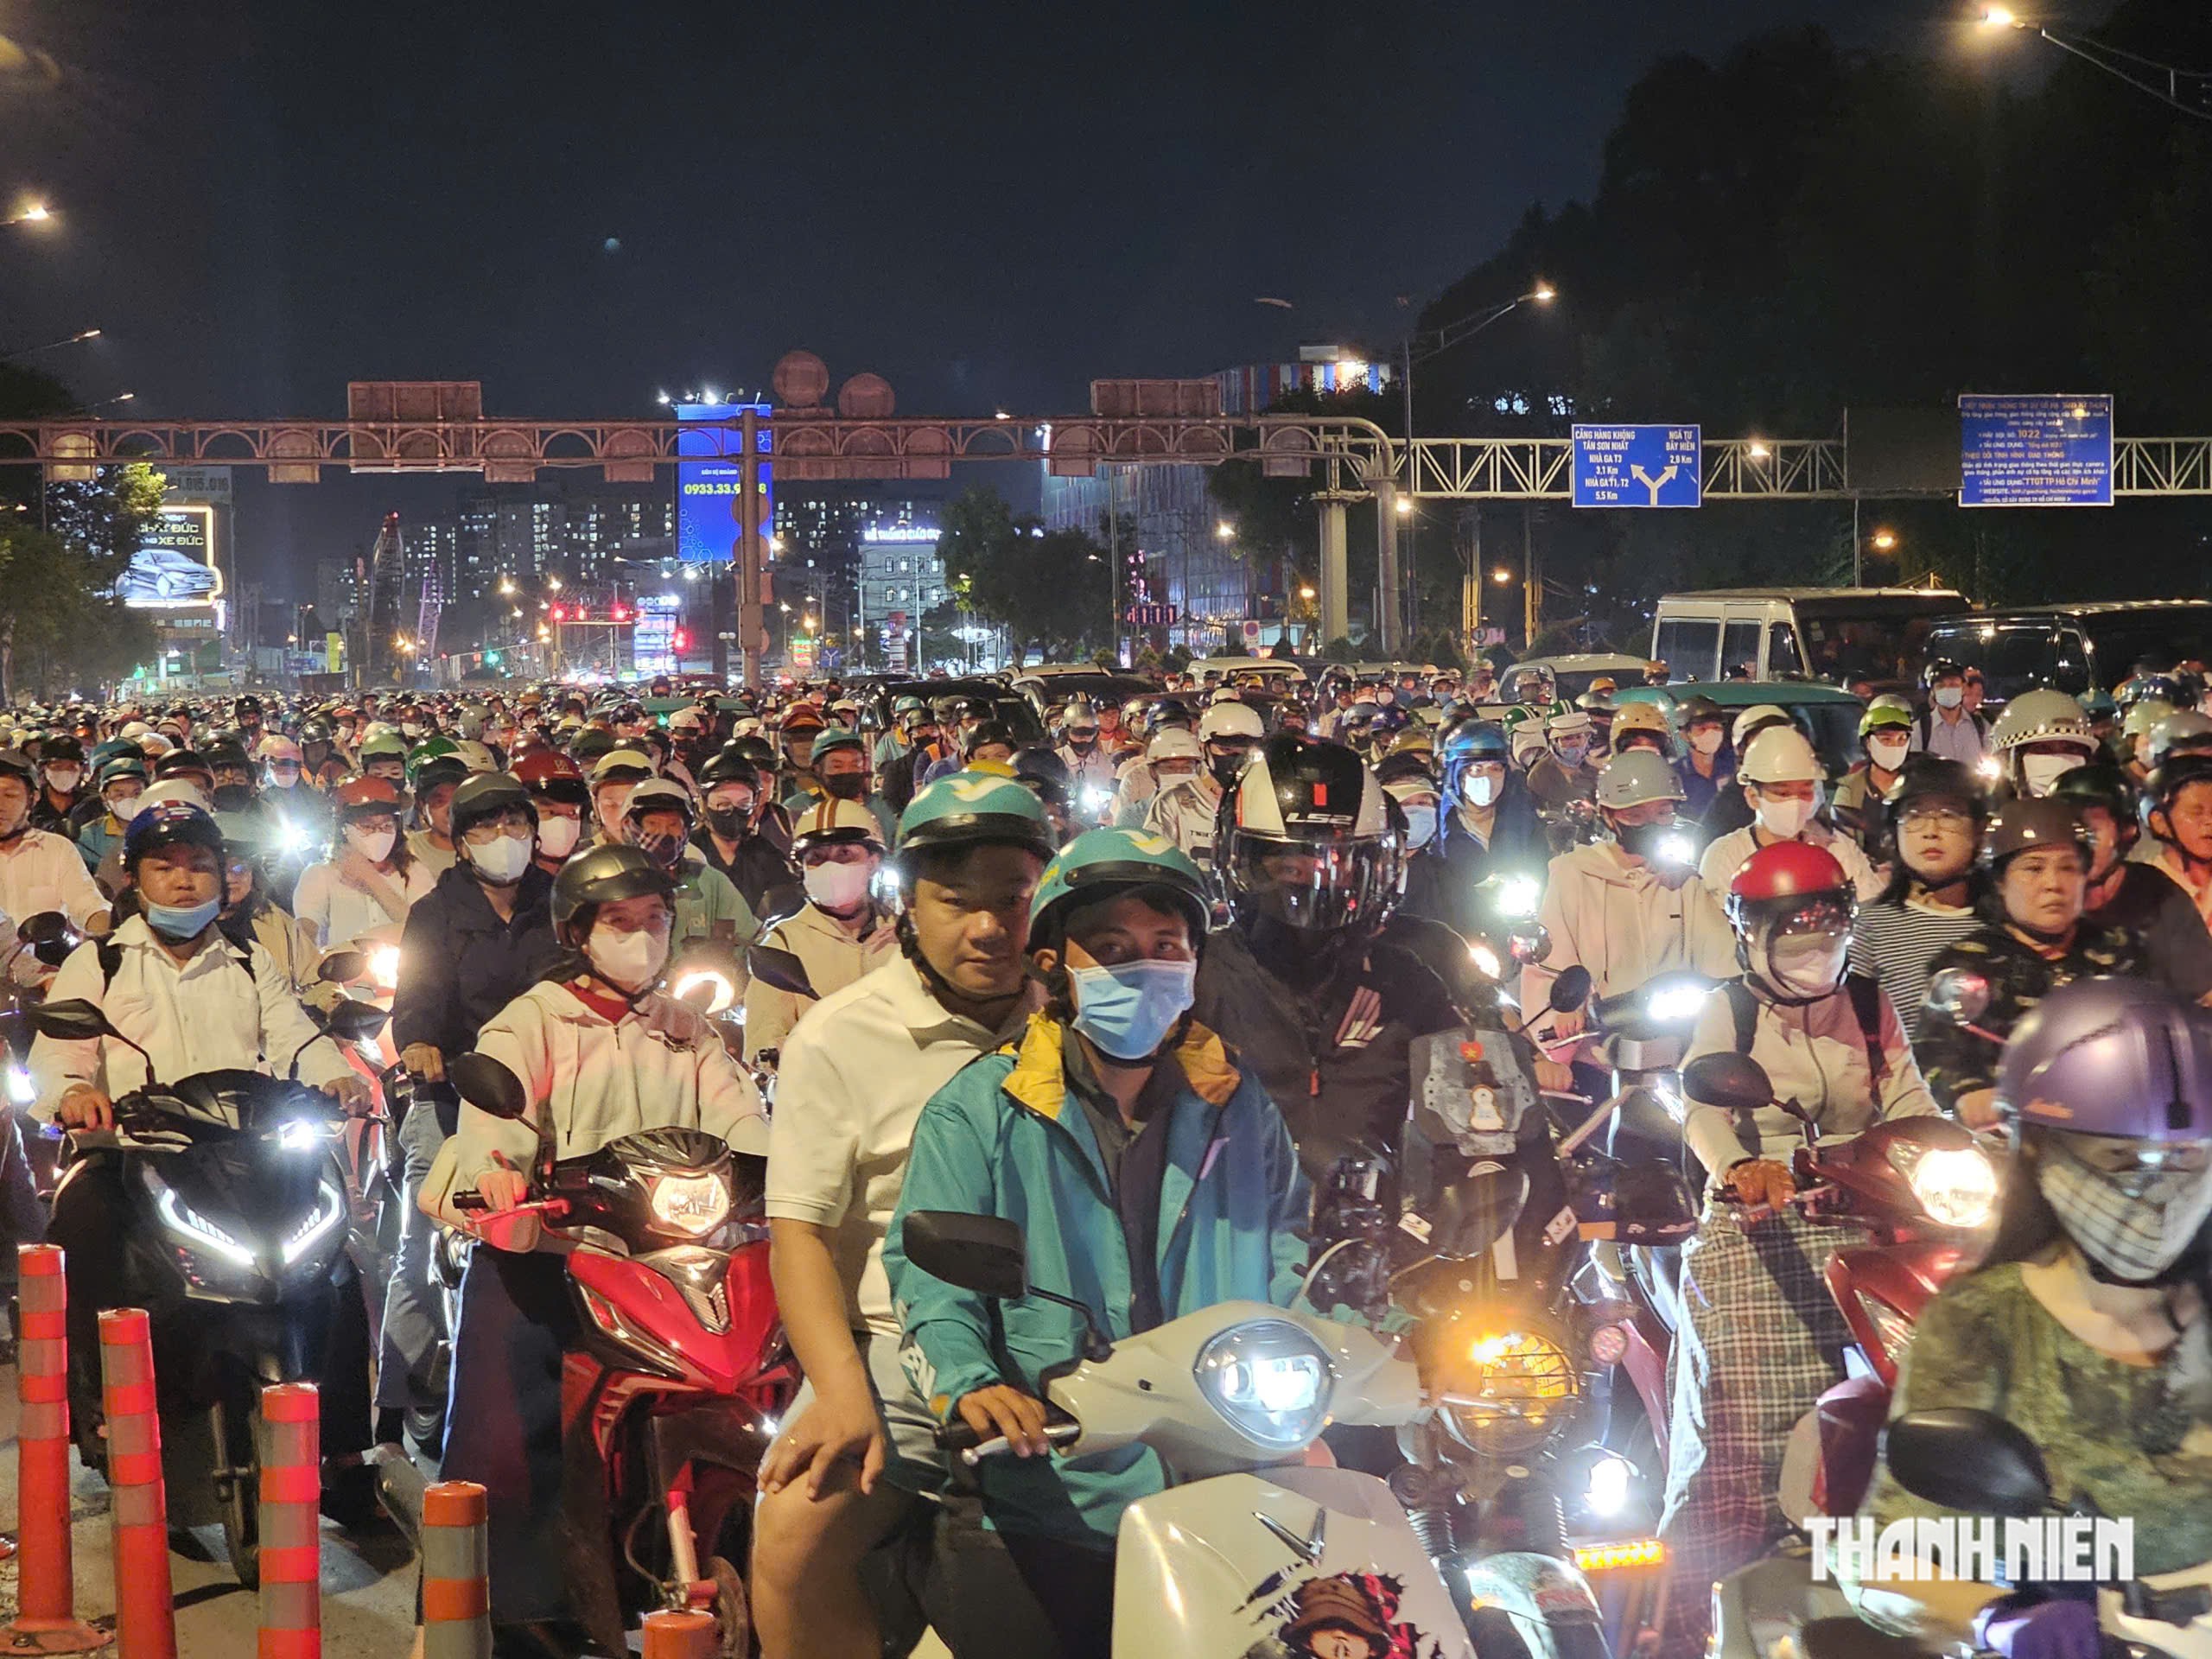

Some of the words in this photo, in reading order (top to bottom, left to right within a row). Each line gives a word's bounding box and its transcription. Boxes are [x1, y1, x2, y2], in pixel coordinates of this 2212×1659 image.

[1575, 428, 1592, 440] CẢNG
[1594, 429, 1611, 440] HÀNG
[1583, 440, 1595, 450] TÂN
[1590, 453, 1603, 463] NHÀ
[1604, 454, 1613, 463] GA
[1614, 454, 1623, 463] T3
[1607, 465, 1618, 474] Km
[1585, 475, 1599, 487] NHÀ
[1599, 479, 1609, 487] GA
[1621, 479, 1630, 487] T2
[683, 483, 766, 495] 0933.33.98
[1607, 491, 1618, 500] Km
[158, 536, 175, 545] XE
[1285, 812, 1354, 825] LS2
